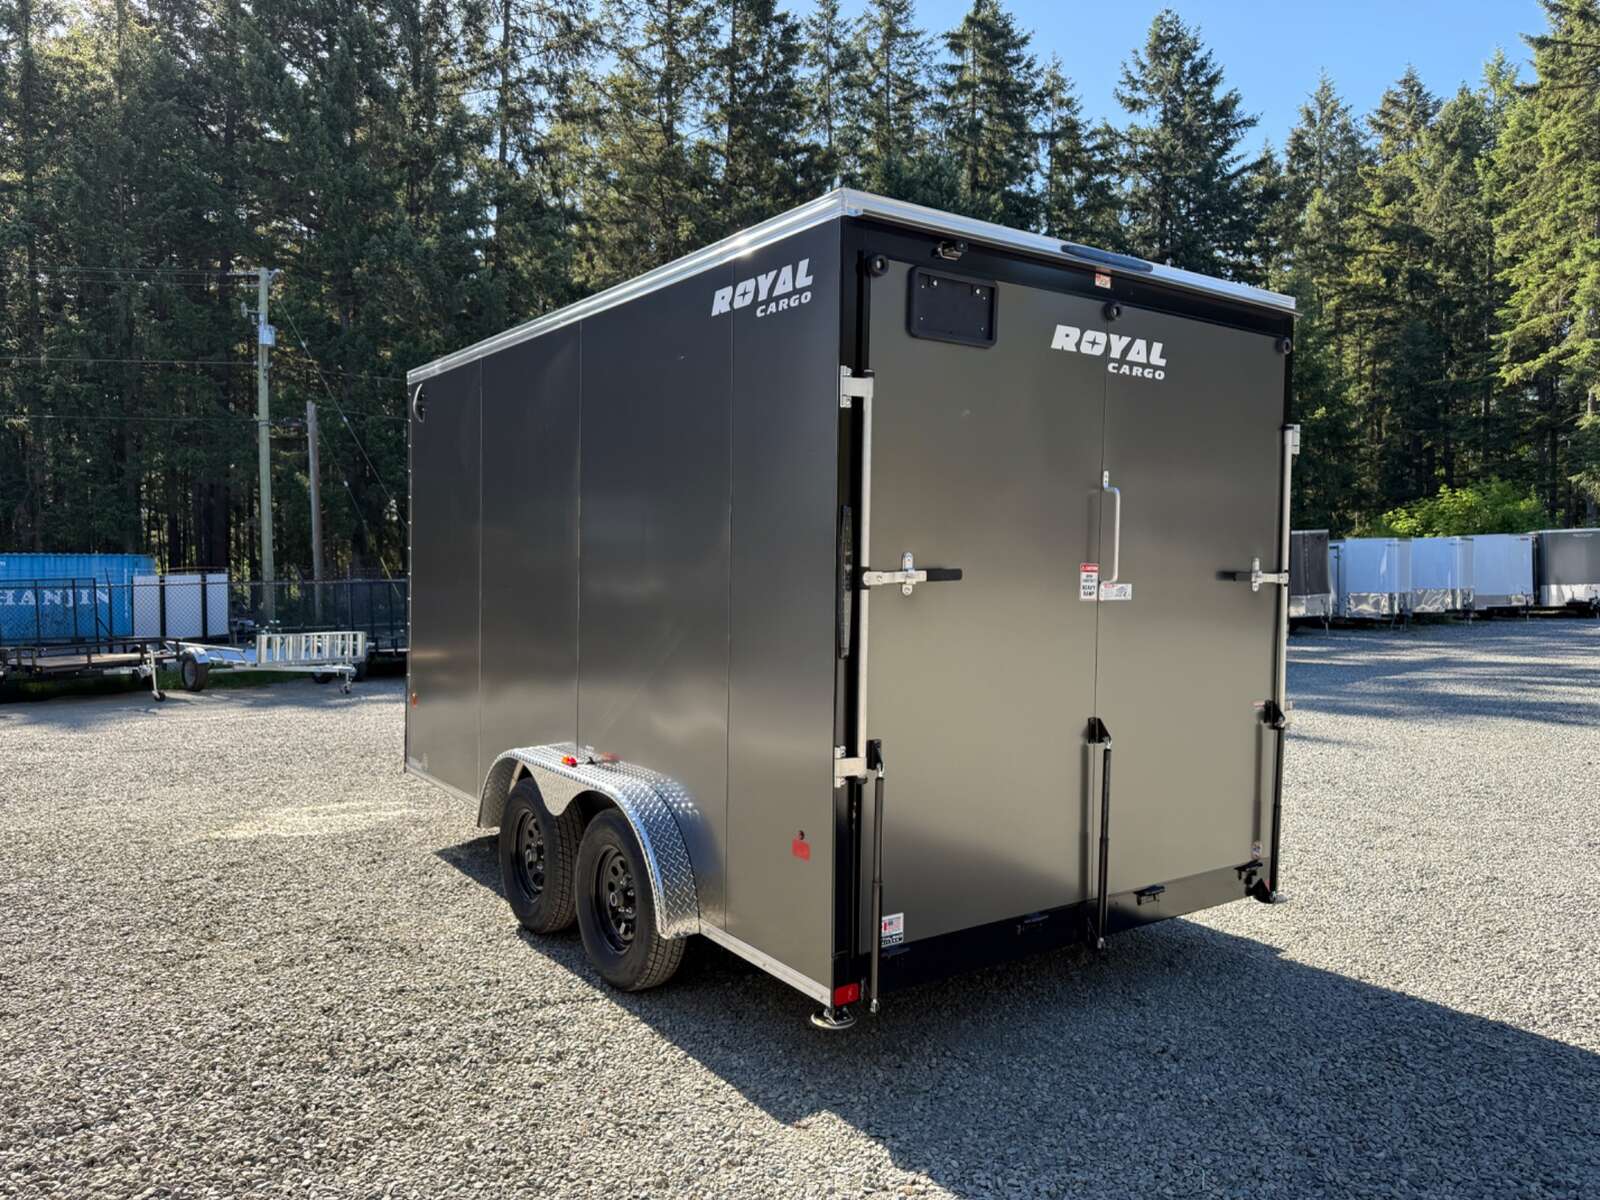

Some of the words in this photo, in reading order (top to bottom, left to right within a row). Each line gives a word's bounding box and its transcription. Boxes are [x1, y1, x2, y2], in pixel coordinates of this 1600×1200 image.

[711, 258, 813, 317] ROYAL
[756, 291, 812, 318] CARGO
[1050, 324, 1167, 367] ROYAL
[1107, 362, 1165, 380] CARGO
